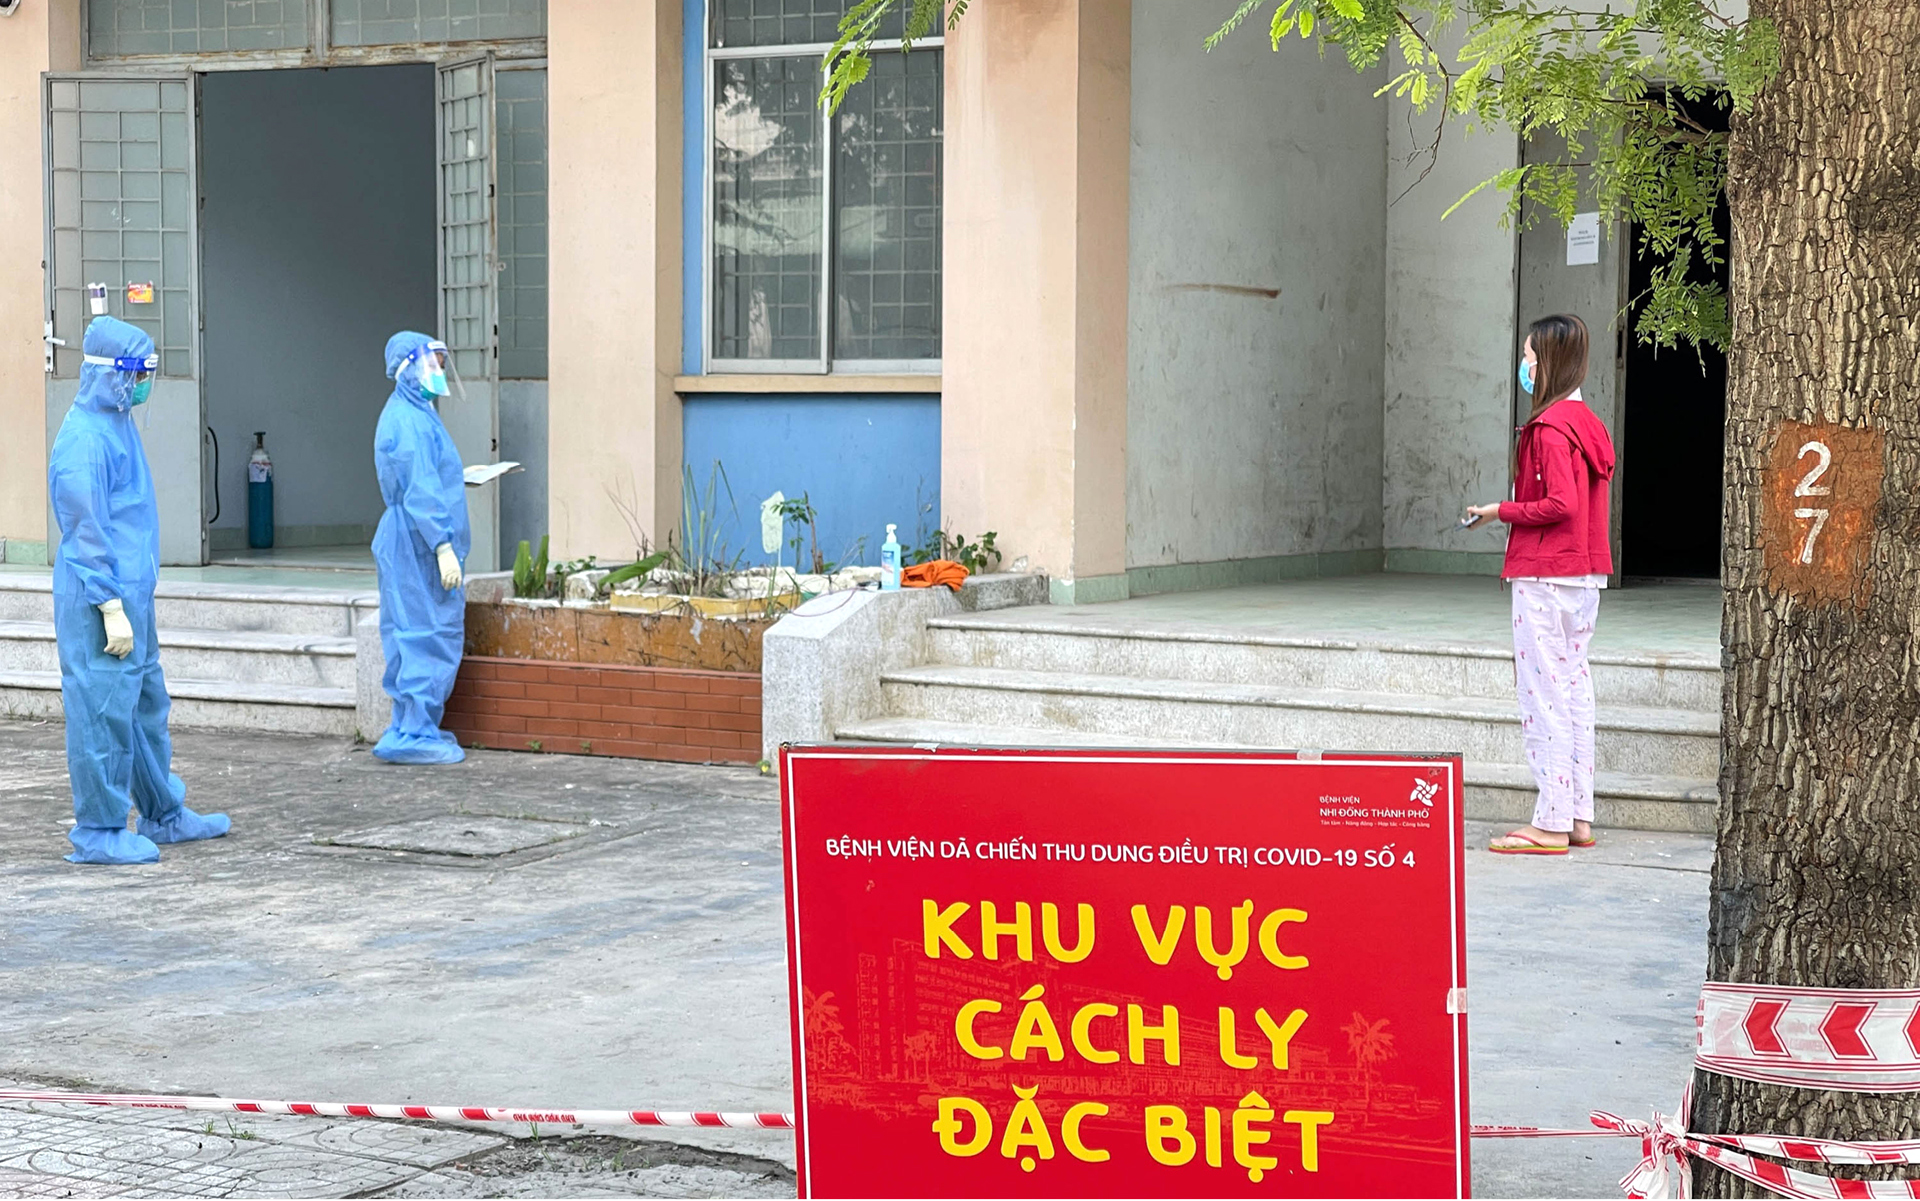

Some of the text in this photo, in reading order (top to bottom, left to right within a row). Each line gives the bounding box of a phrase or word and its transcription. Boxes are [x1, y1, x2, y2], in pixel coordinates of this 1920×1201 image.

[1794, 441, 1832, 498] 2
[1794, 507, 1830, 564] 7
[1319, 805, 1430, 819] NHI ĐỒNG THÀNH PHỐ
[1320, 795, 1360, 804] BỆNH VIỆN
[826, 834, 1416, 868] BỆNH VIỆN DÃ CHIẾN THU DUNG ĐIỀU TRỊ COVID-19 SỐ 4
[922, 899, 1310, 981] KHU VỰC
[954, 984, 1309, 1070] CÁCH LY
[931, 1083, 1335, 1183] ĐẶC BIỆT
